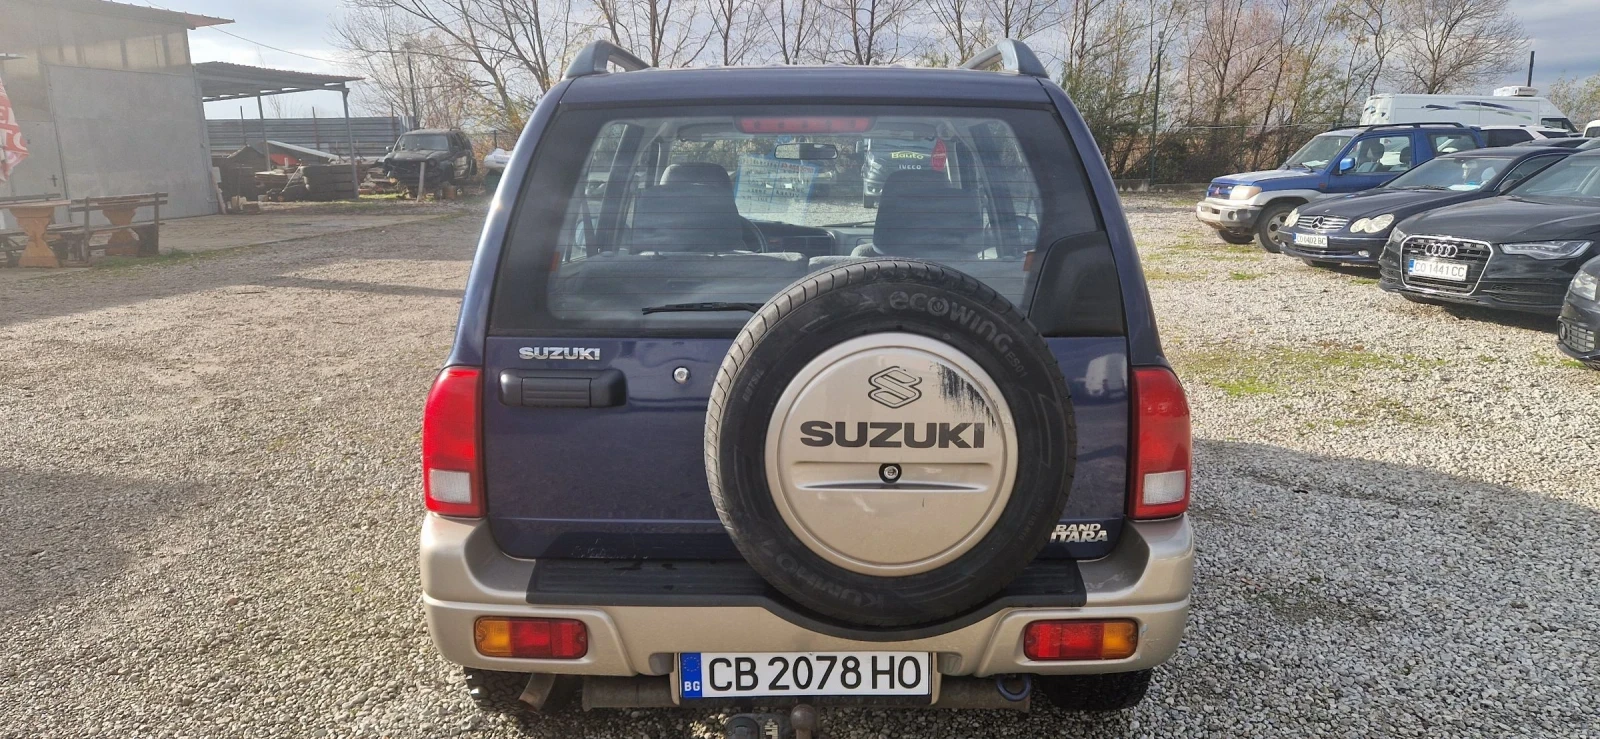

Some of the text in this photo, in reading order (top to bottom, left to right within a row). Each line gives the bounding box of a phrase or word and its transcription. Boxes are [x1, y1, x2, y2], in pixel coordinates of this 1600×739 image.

[1429, 264, 1449, 275] 1441
[1452, 266, 1465, 278] CC
[518, 347, 600, 360] SUZUKI
[800, 420, 985, 449] SUZUKI
[1055, 523, 1101, 532] RAND
[708, 655, 922, 692] CB 2078 HO
[684, 681, 701, 692] BG
